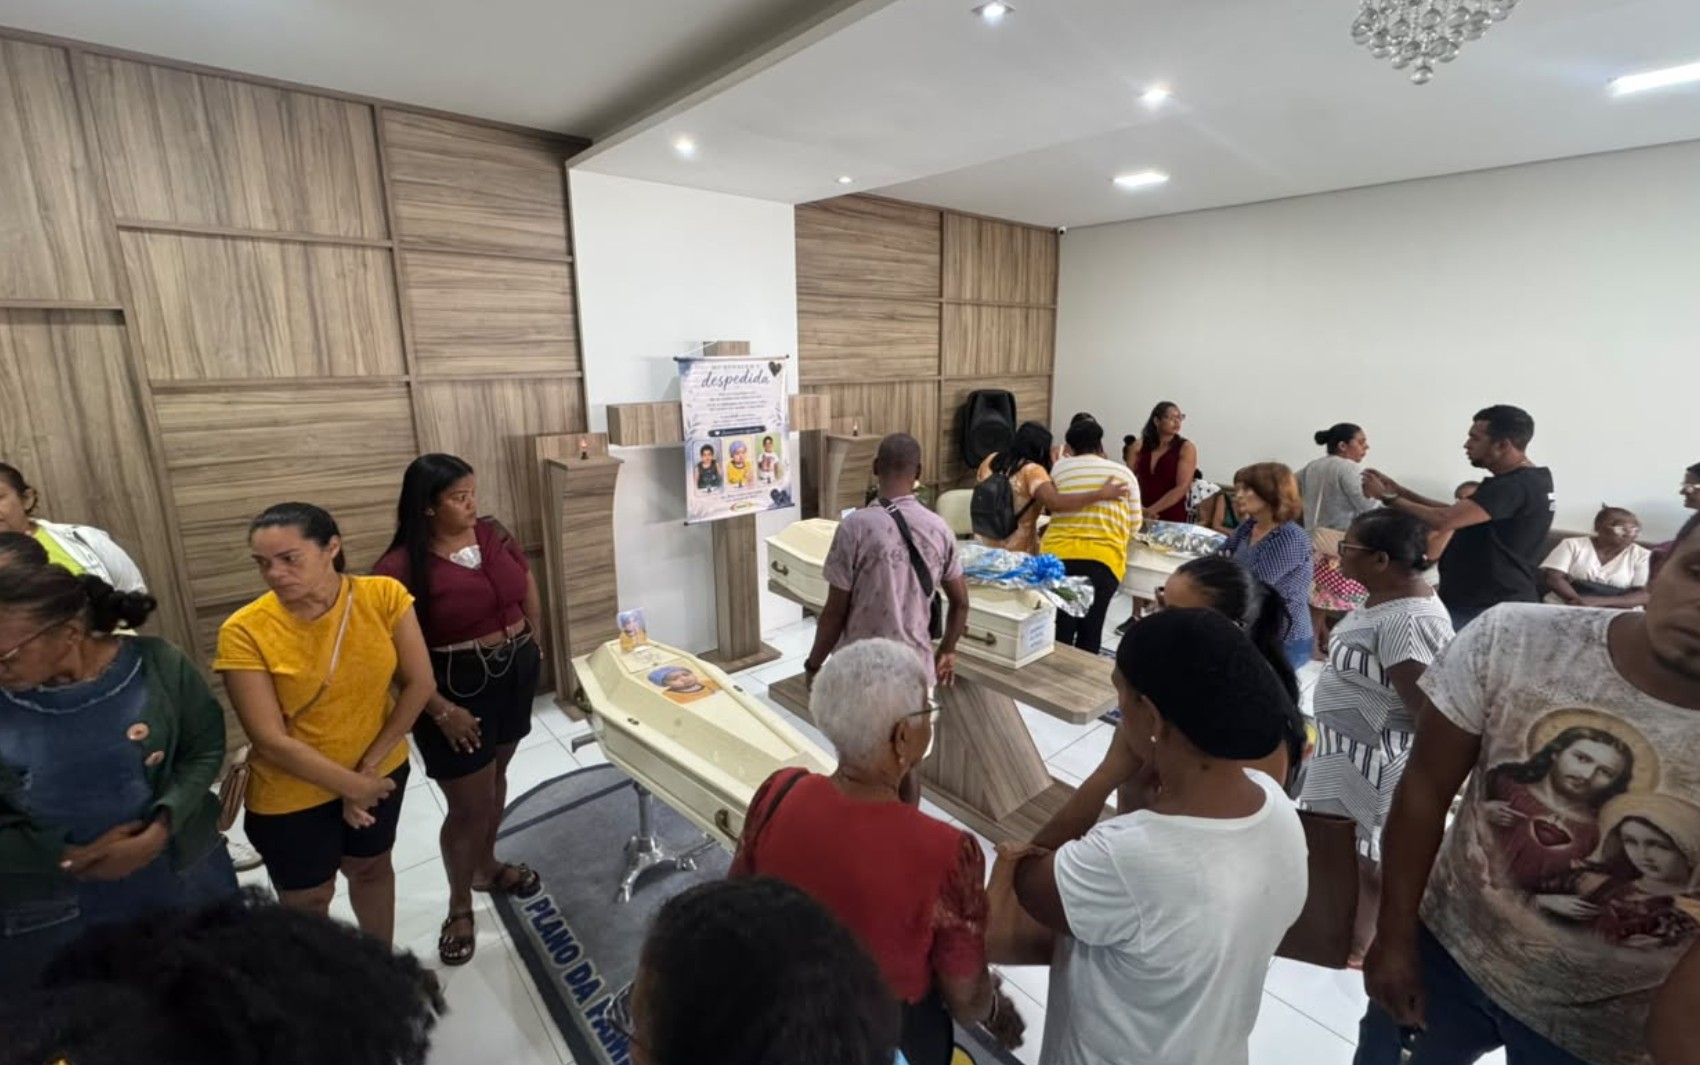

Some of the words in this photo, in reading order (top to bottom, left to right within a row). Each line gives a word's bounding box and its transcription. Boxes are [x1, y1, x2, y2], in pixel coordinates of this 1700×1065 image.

[701, 368, 770, 391] despedida
[523, 896, 581, 967] PLANO
[563, 960, 603, 1006] DA
